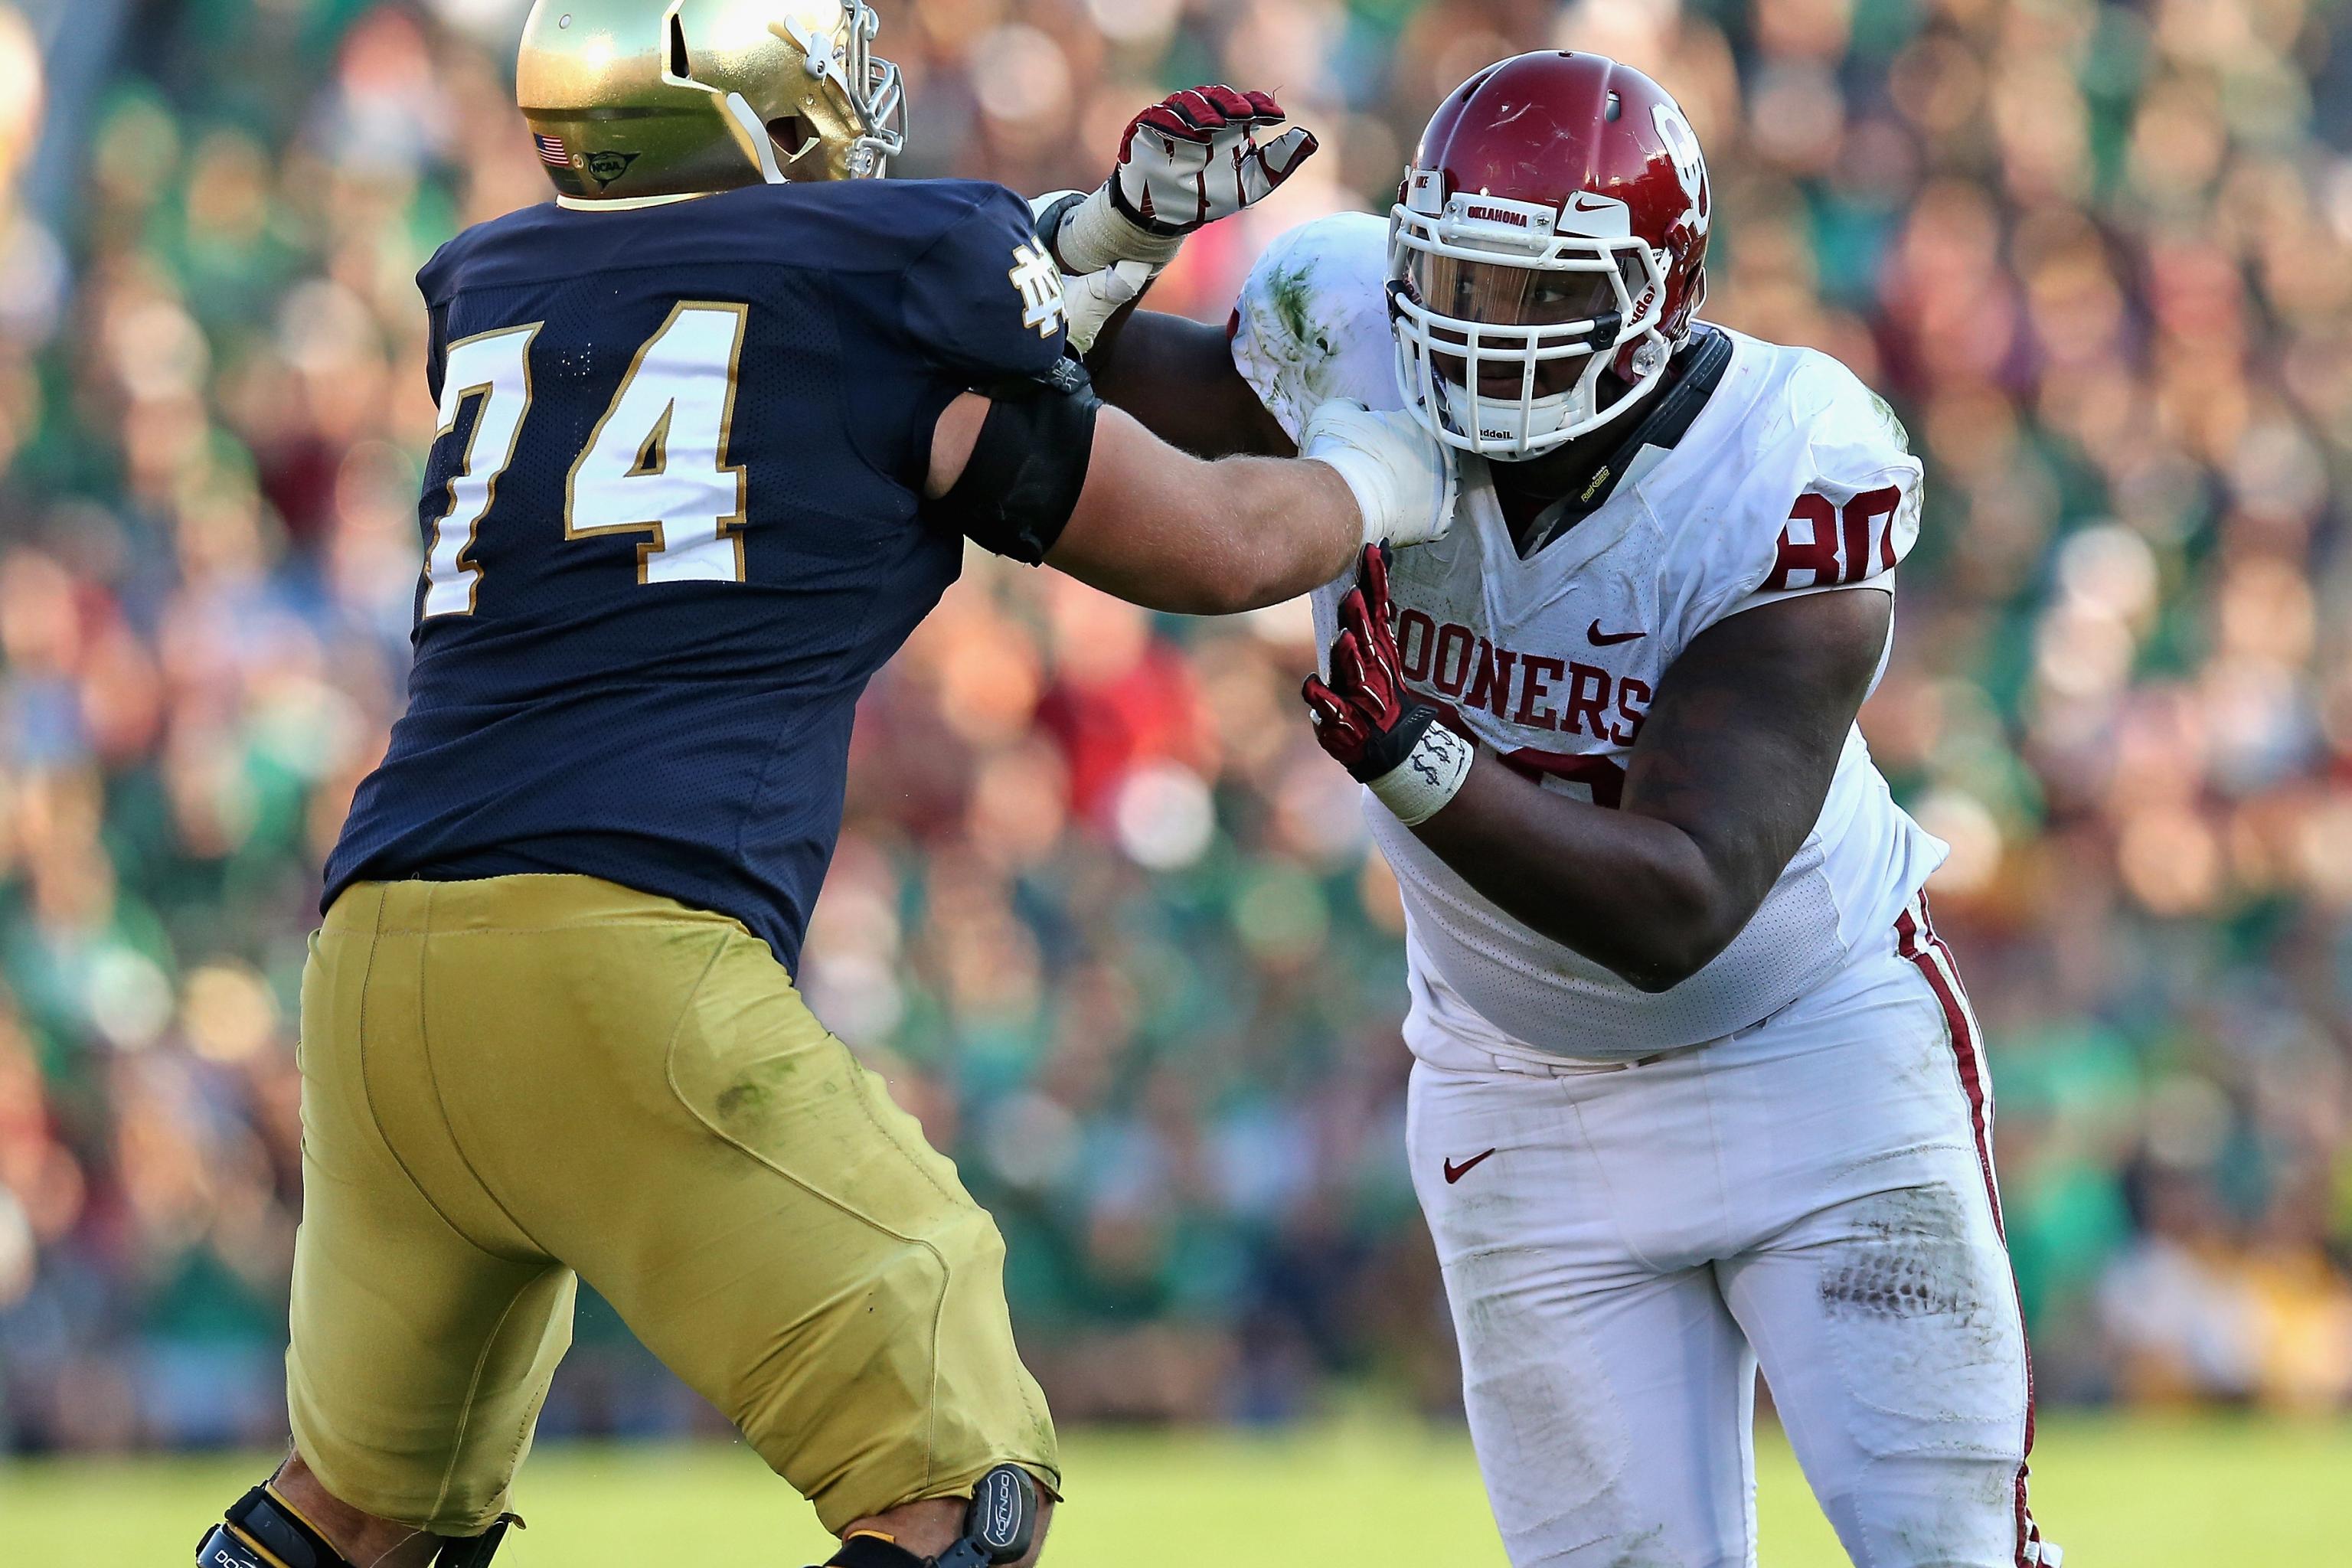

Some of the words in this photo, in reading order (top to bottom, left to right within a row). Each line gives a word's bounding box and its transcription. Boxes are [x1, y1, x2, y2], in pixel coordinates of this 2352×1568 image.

[1468, 206, 1527, 227] OKLAHOMA
[423, 299, 749, 620] 74
[1758, 484, 1902, 590] 80
[1389, 599, 1651, 747] OONERS
[995, 1474, 1012, 1543] DONJOY
